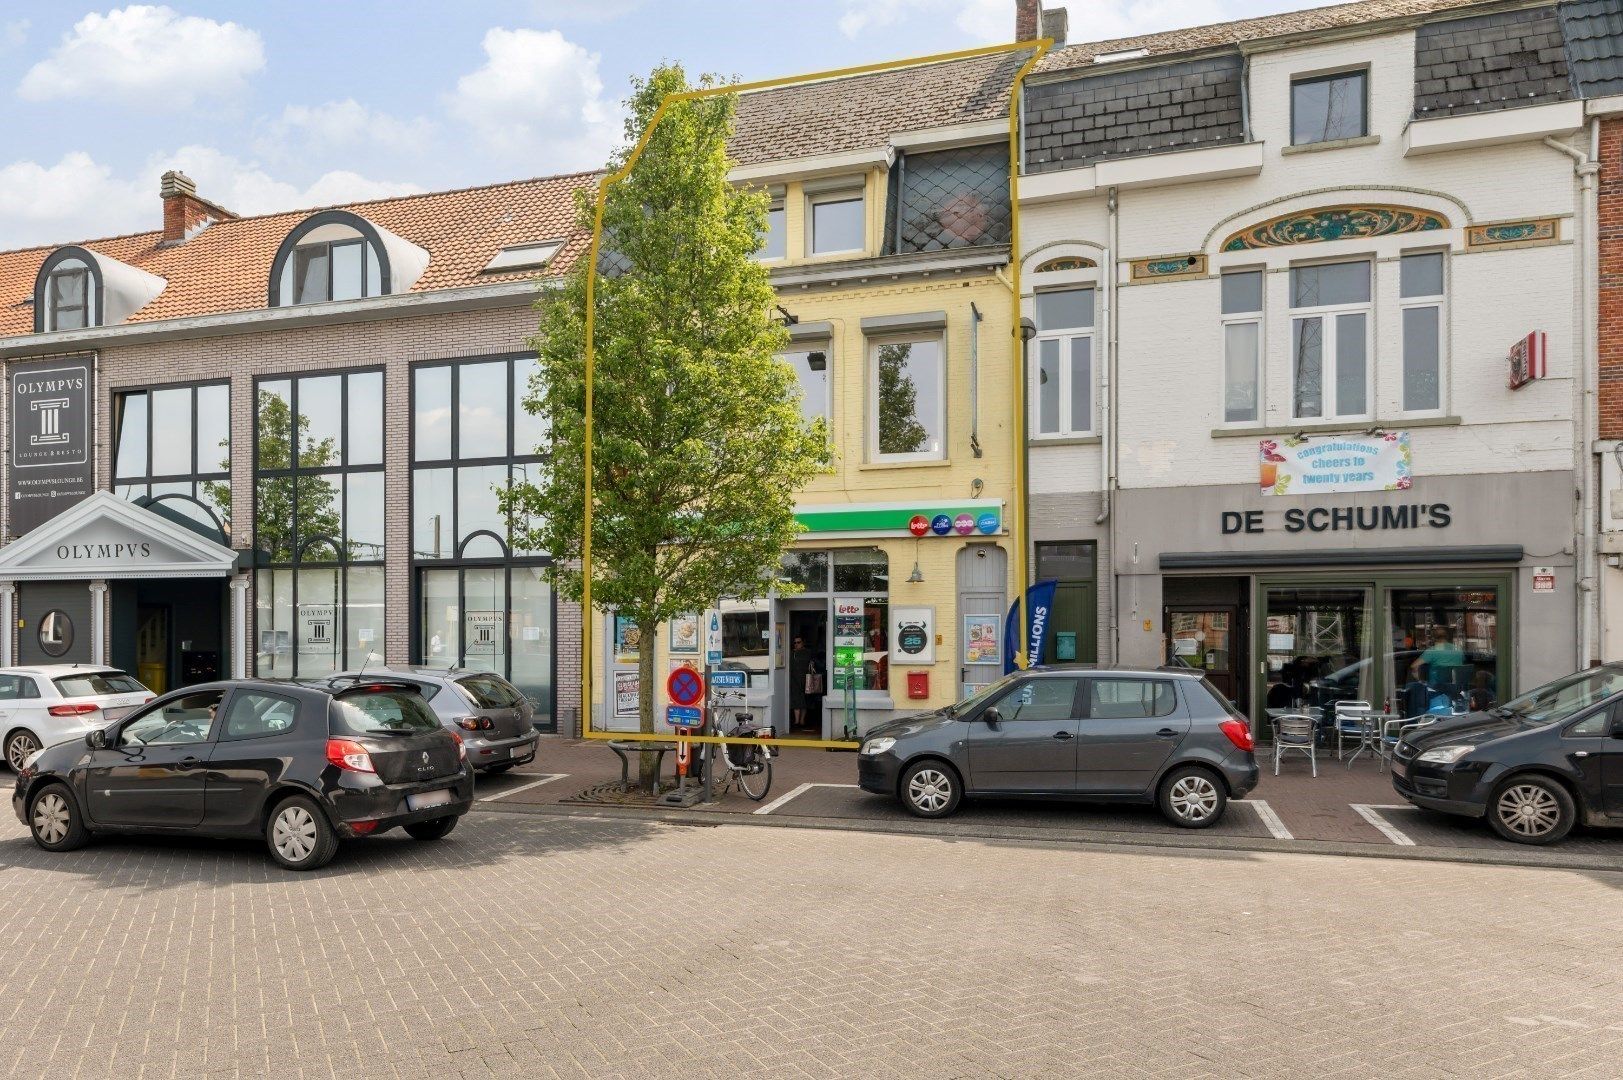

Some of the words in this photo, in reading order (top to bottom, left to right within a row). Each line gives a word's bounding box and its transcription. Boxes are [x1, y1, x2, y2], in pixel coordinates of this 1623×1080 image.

[17, 378, 83, 394] OLYMPVS
[1296, 442, 1379, 460] congratulations
[1312, 457, 1350, 469] cheers
[1353, 456, 1365, 467] to
[1302, 472, 1341, 485] twenty
[1342, 471, 1374, 484] years
[1221, 510, 1264, 534] DE
[1284, 503, 1451, 533] SCHUMI'S
[57, 542, 150, 560] OLYMPVS
